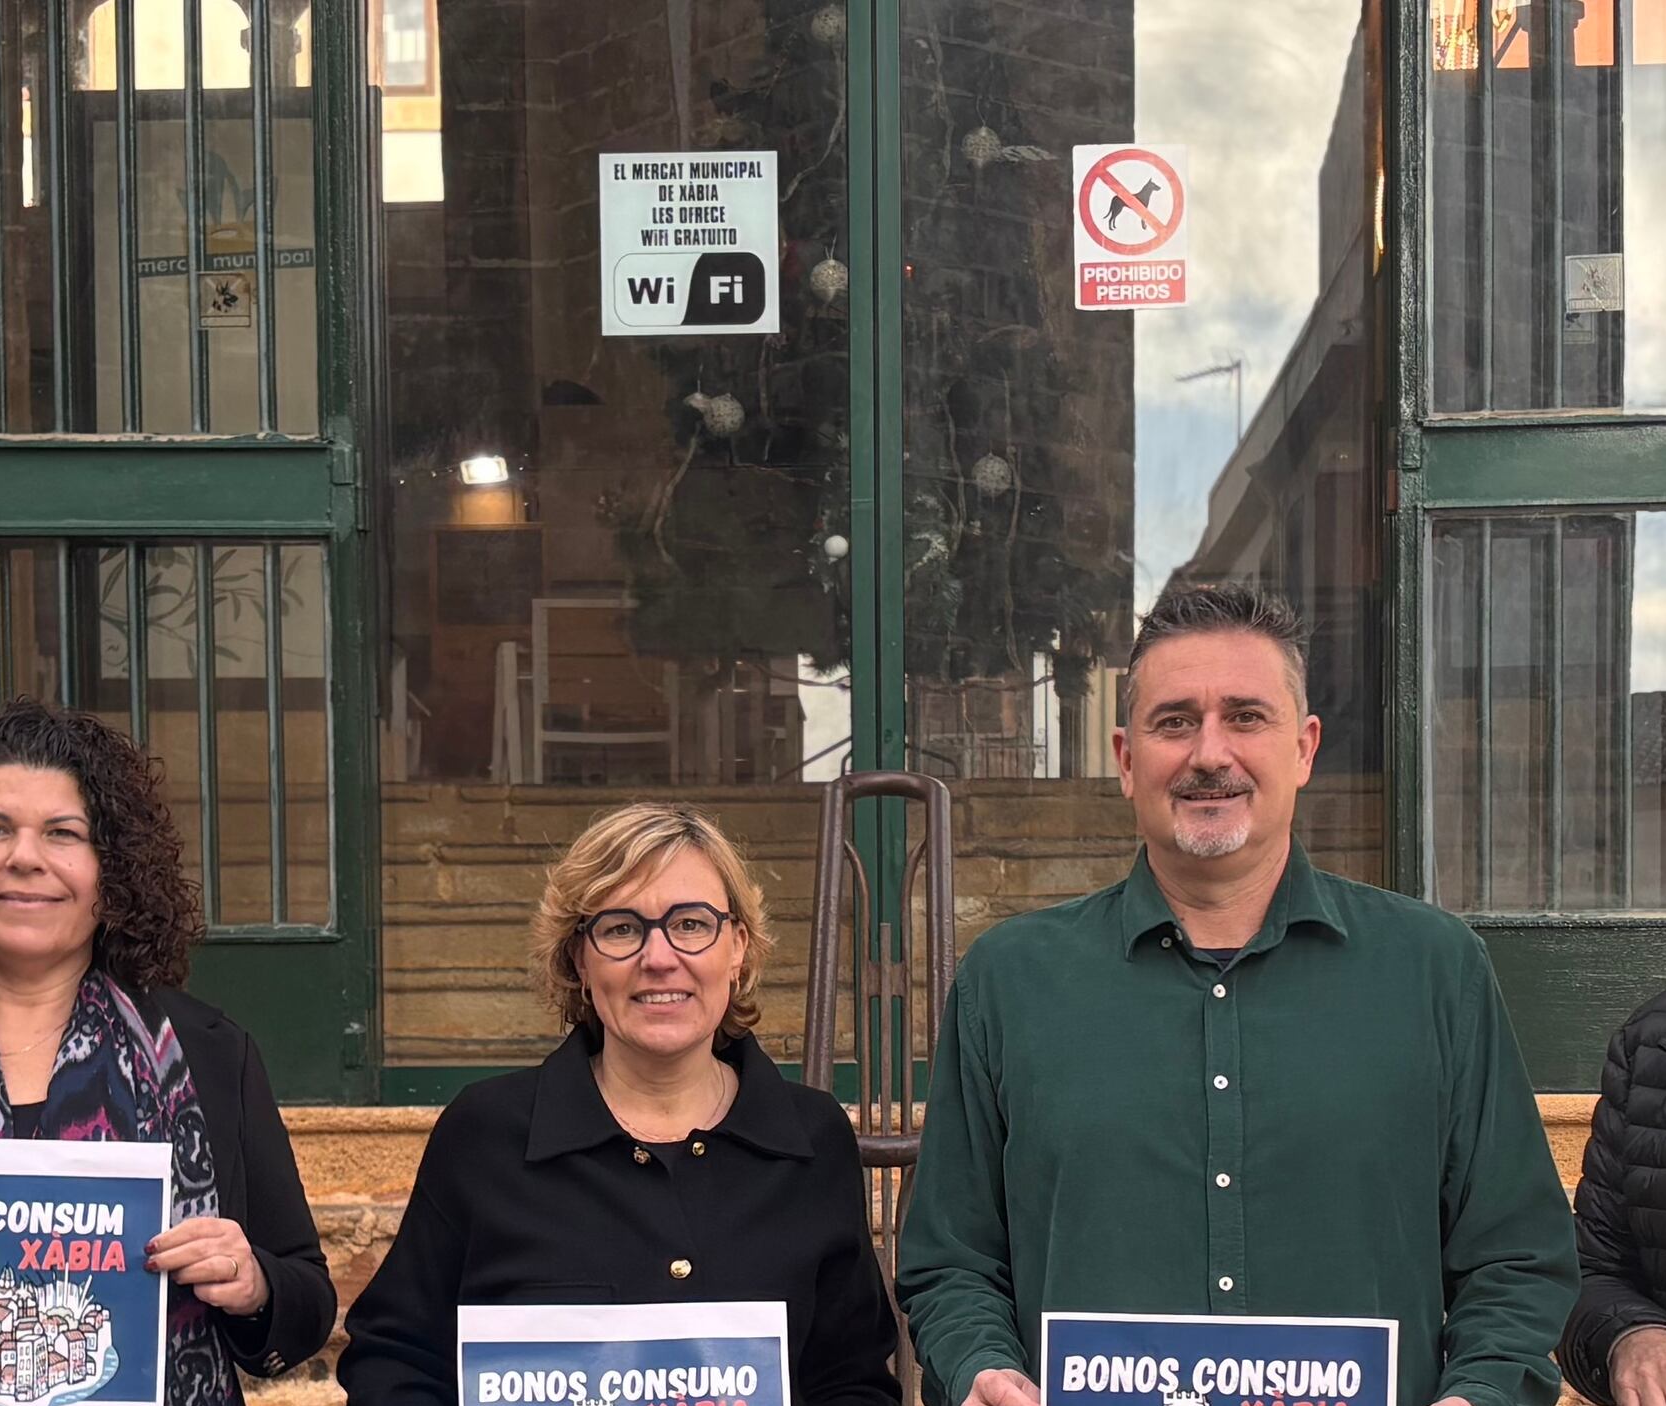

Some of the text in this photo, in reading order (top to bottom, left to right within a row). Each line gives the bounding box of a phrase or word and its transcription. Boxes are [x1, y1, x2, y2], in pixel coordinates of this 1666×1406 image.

[614, 161, 763, 180] EL MERCAT MUNICIPAL
[659, 181, 719, 202] DE XÀBIA
[652, 206, 726, 224] LES OFRECE
[641, 228, 737, 246] WiFi GRATUITO
[1083, 264, 1182, 283] PROHIBIDO
[1096, 284, 1171, 301] PERROS
[18, 1232, 127, 1272] XÀBIA
[478, 1365, 758, 1403] BONOS CONSUMO
[1062, 1355, 1362, 1399] BONOS CONSUMO
